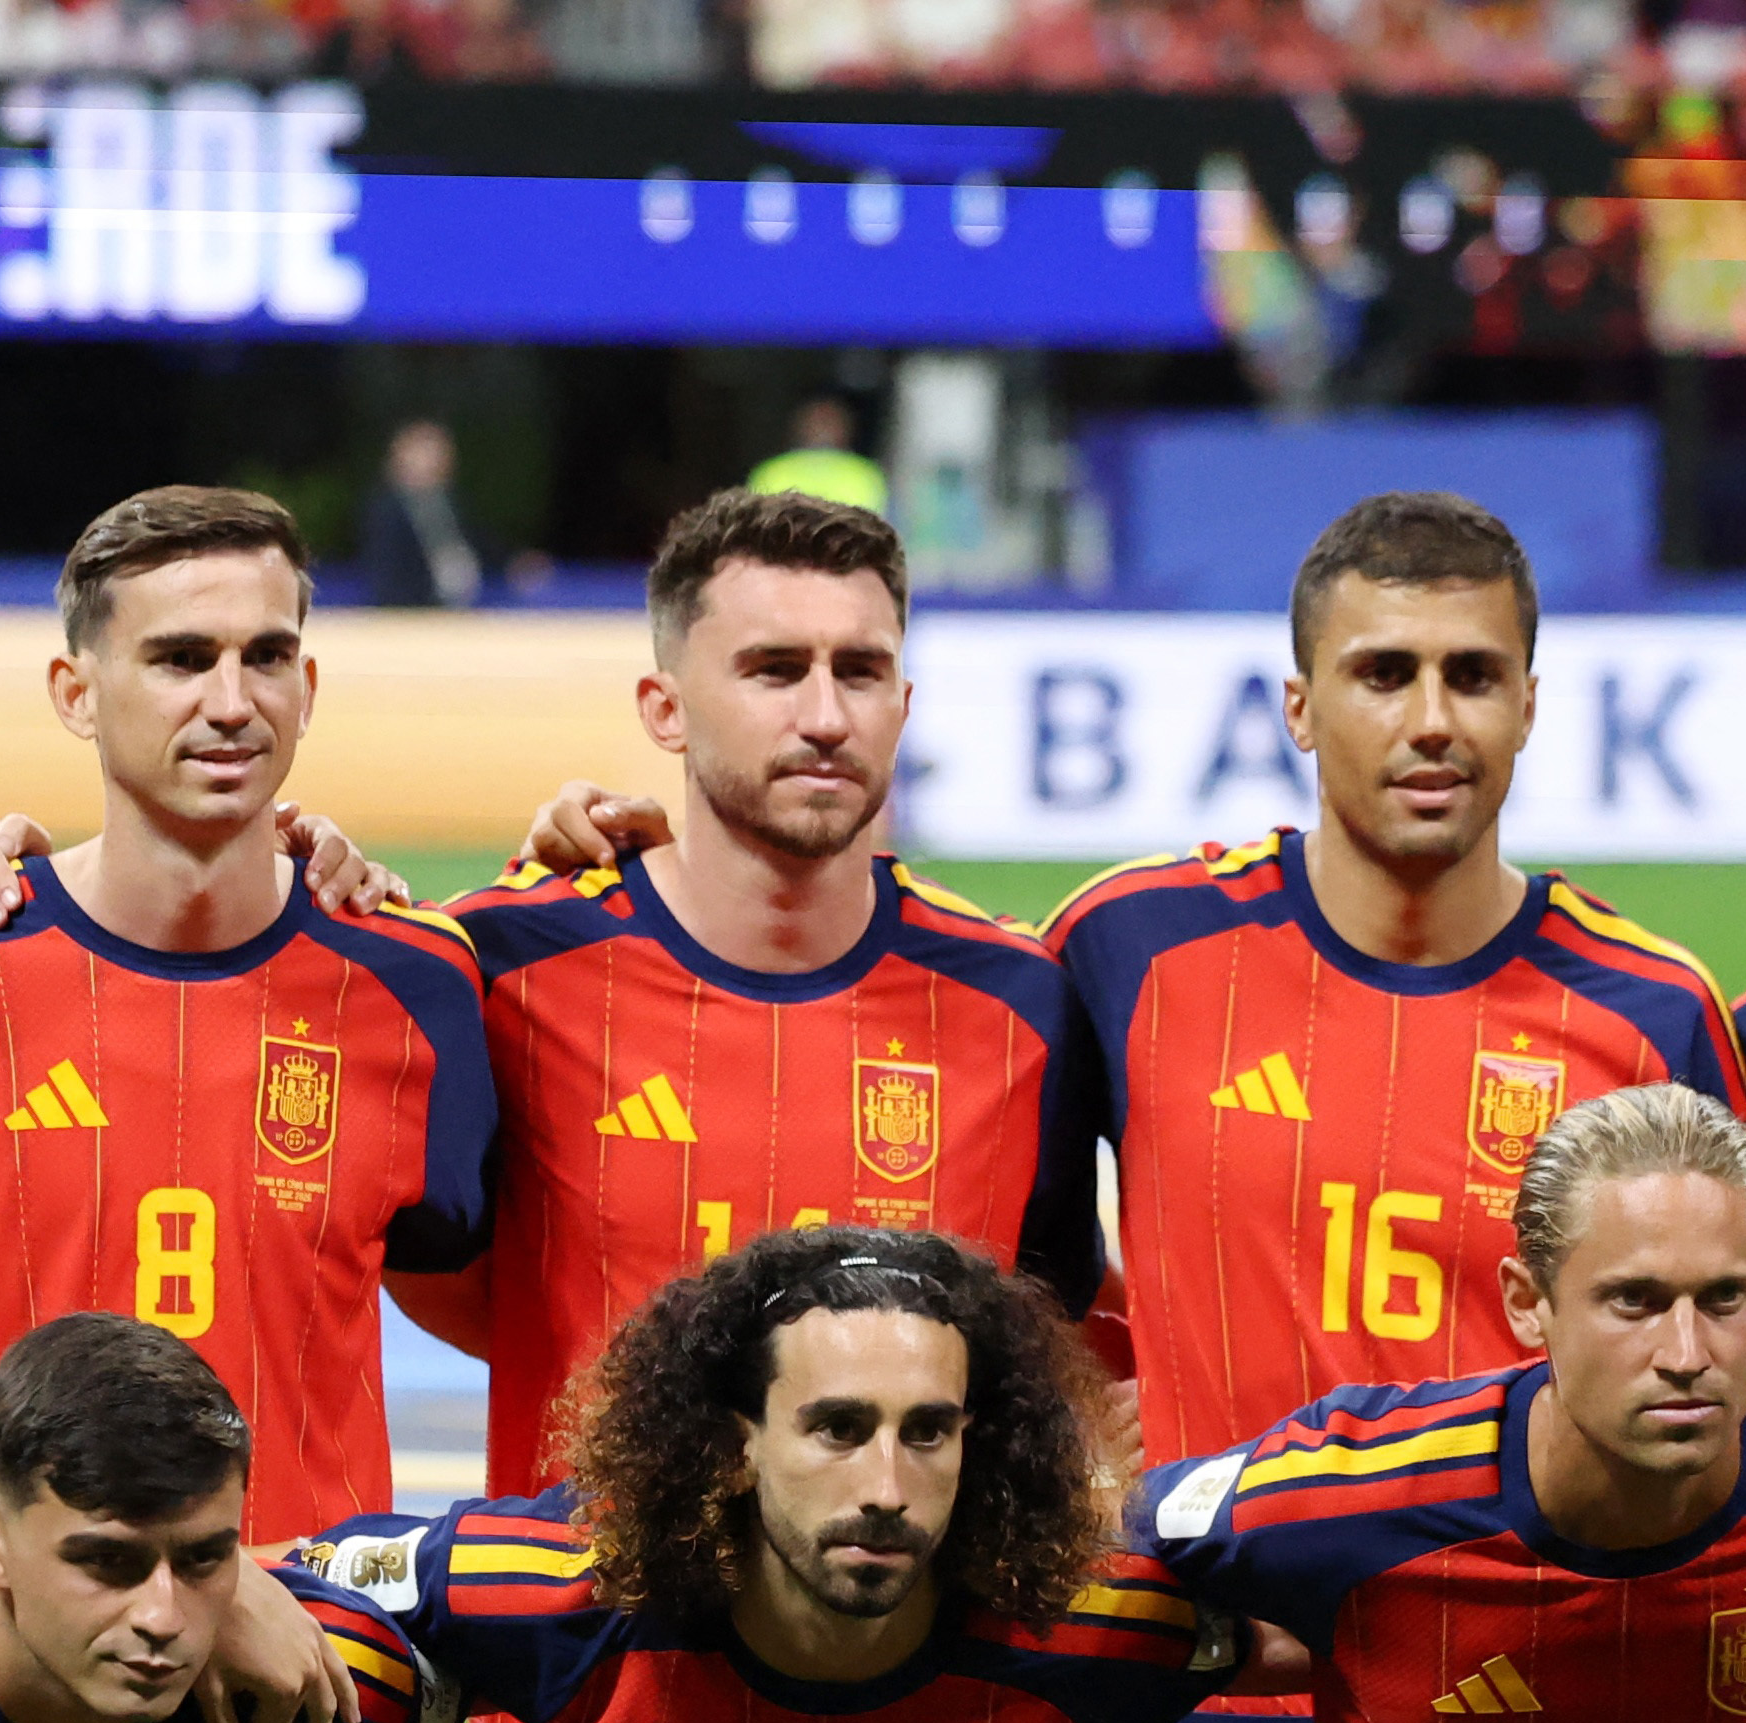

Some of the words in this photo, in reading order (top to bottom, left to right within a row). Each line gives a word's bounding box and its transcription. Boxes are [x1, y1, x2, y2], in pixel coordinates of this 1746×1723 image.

[1029, 668, 1699, 806] BAK
[135, 1188, 216, 1338] 8
[1320, 1182, 1443, 1341] 16
